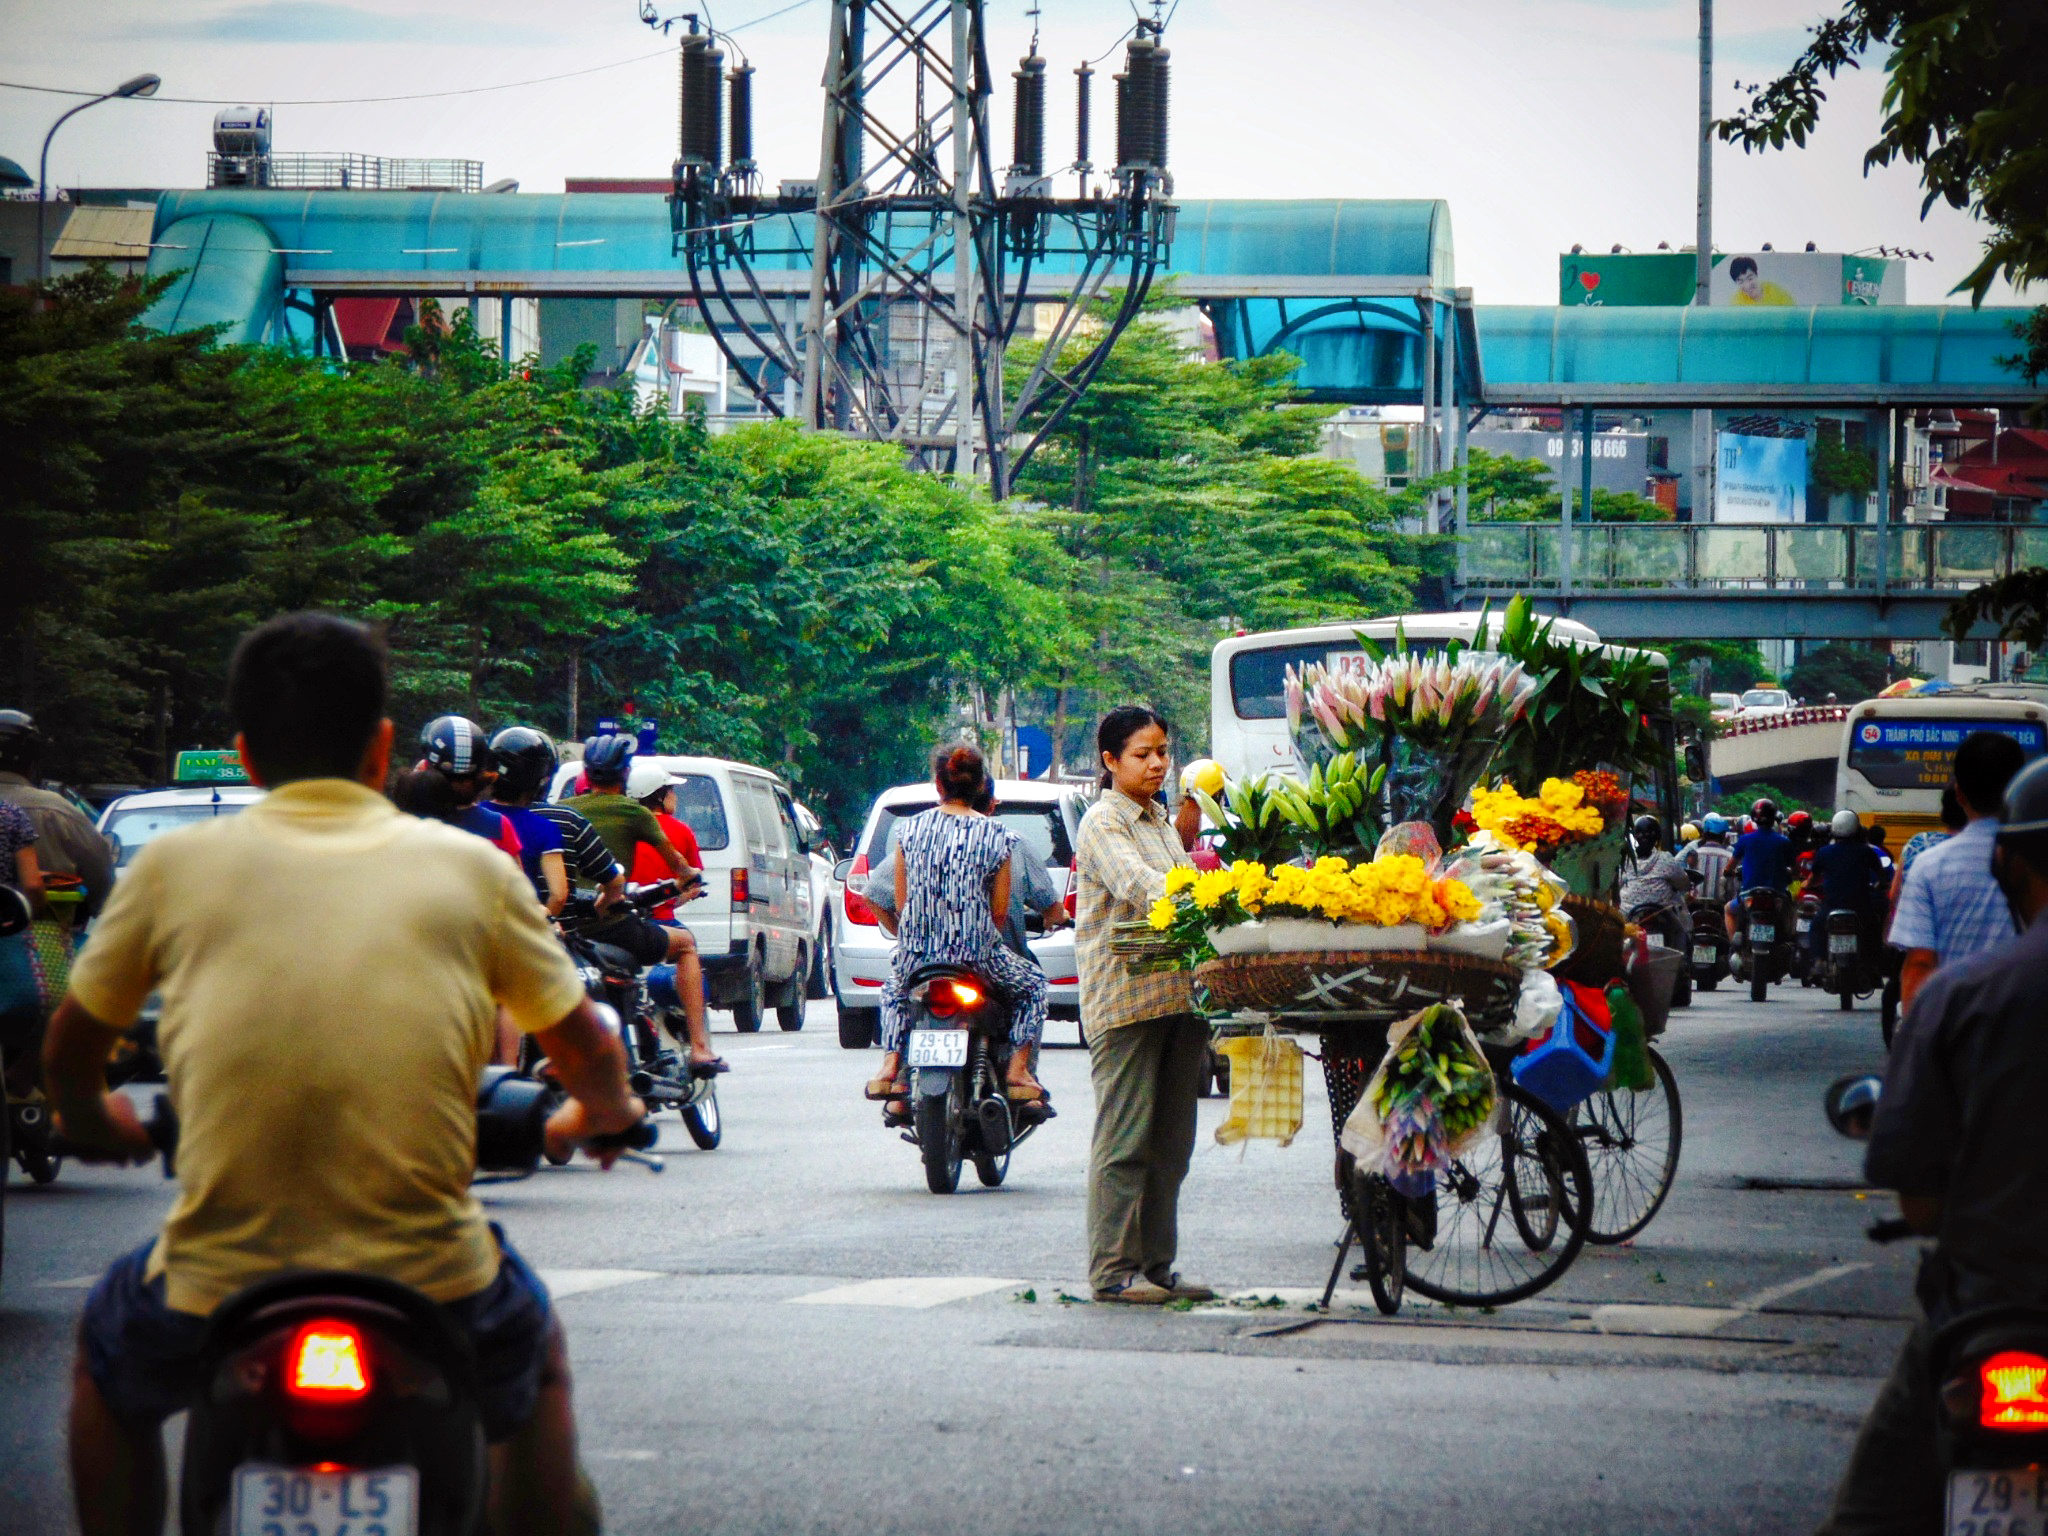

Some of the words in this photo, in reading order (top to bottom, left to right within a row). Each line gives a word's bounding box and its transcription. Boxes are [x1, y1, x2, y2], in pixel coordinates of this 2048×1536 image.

[1604, 439, 1627, 458] 666
[1865, 728, 1879, 740] 54
[1942, 729, 1960, 743] NINH
[920, 1033, 959, 1048] 29-C1
[913, 1048, 962, 1064] 304.17
[262, 1475, 389, 1518] 30-L5
